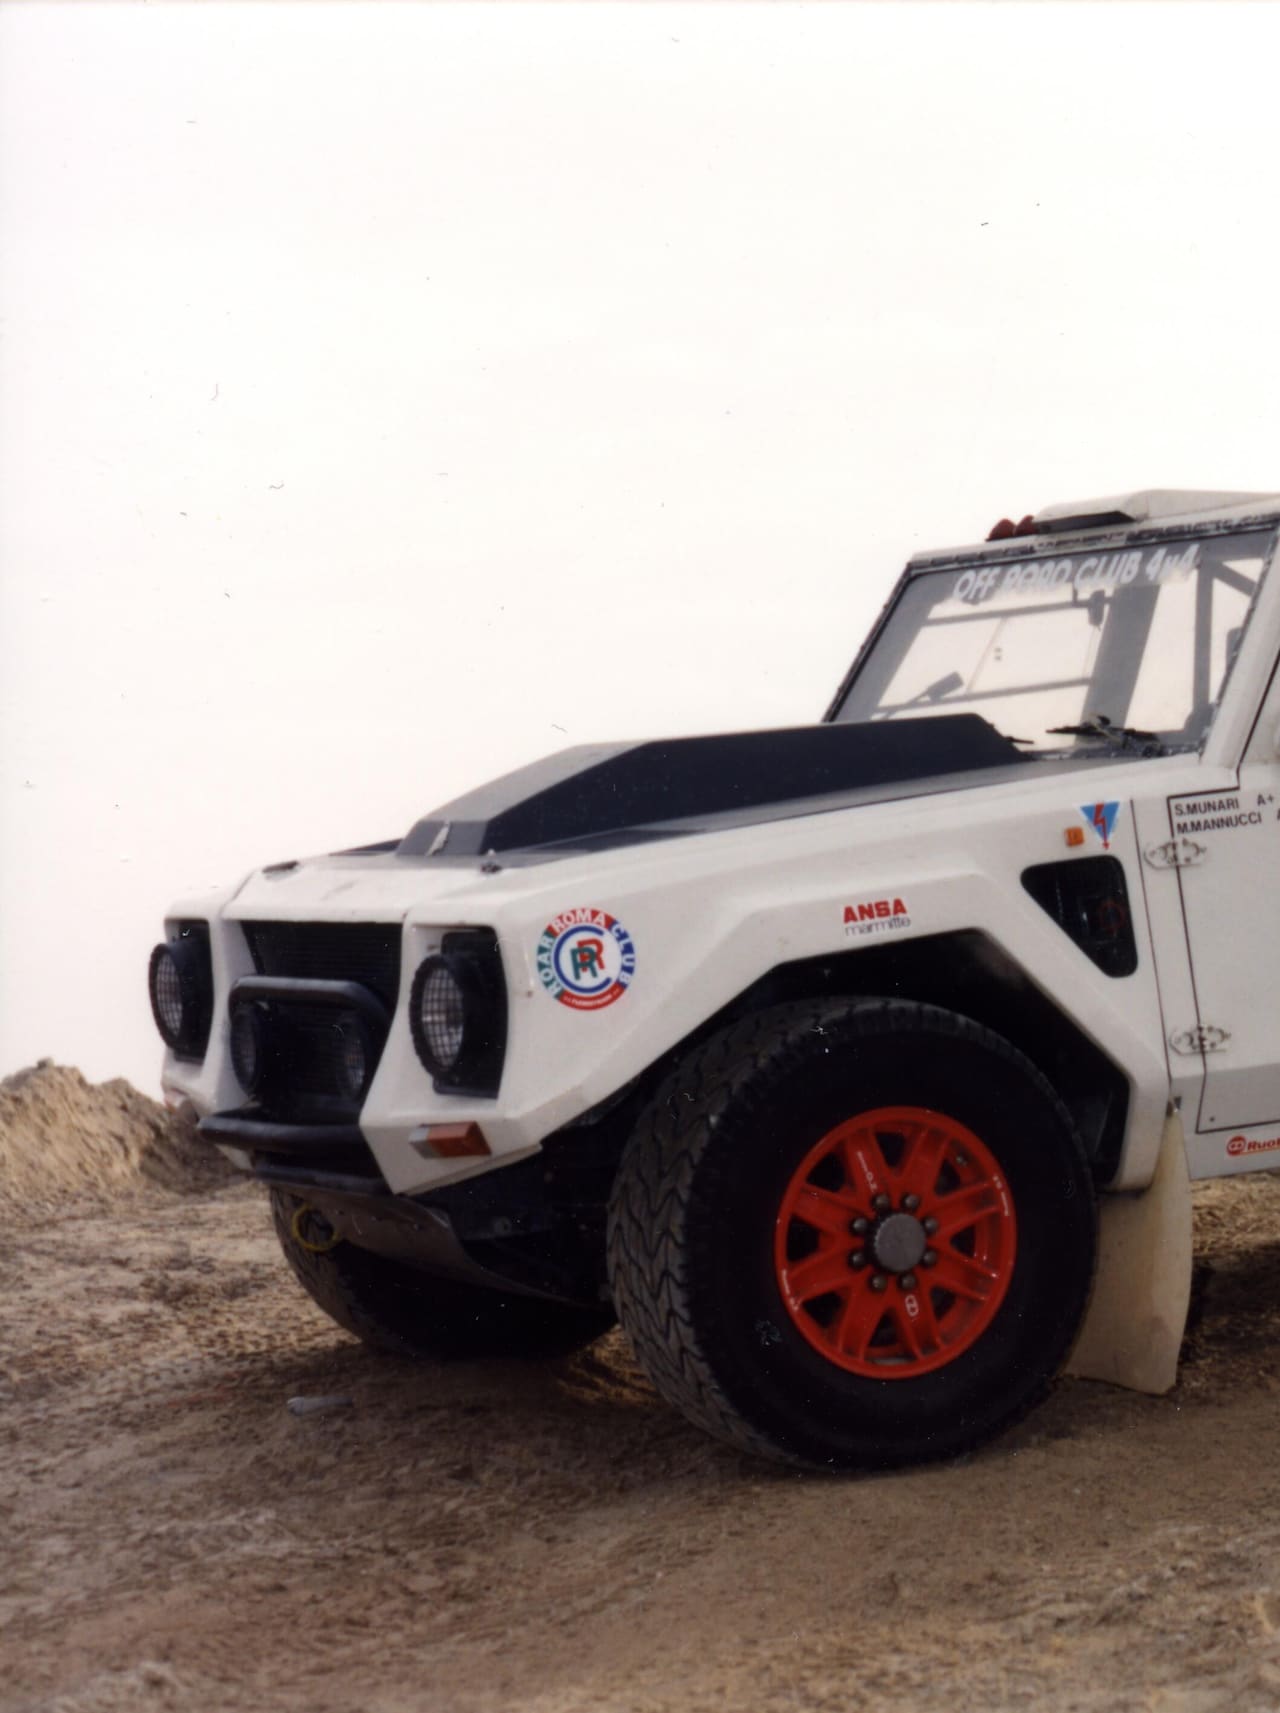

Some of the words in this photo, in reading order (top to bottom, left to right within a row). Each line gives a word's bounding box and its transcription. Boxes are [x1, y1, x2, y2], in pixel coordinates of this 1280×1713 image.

[953, 568, 1000, 601] OFF
[1072, 550, 1143, 590] CLUB
[843, 898, 907, 924] ANSA
[550, 908, 607, 934] ROMA
[611, 922, 636, 986] CLUB
